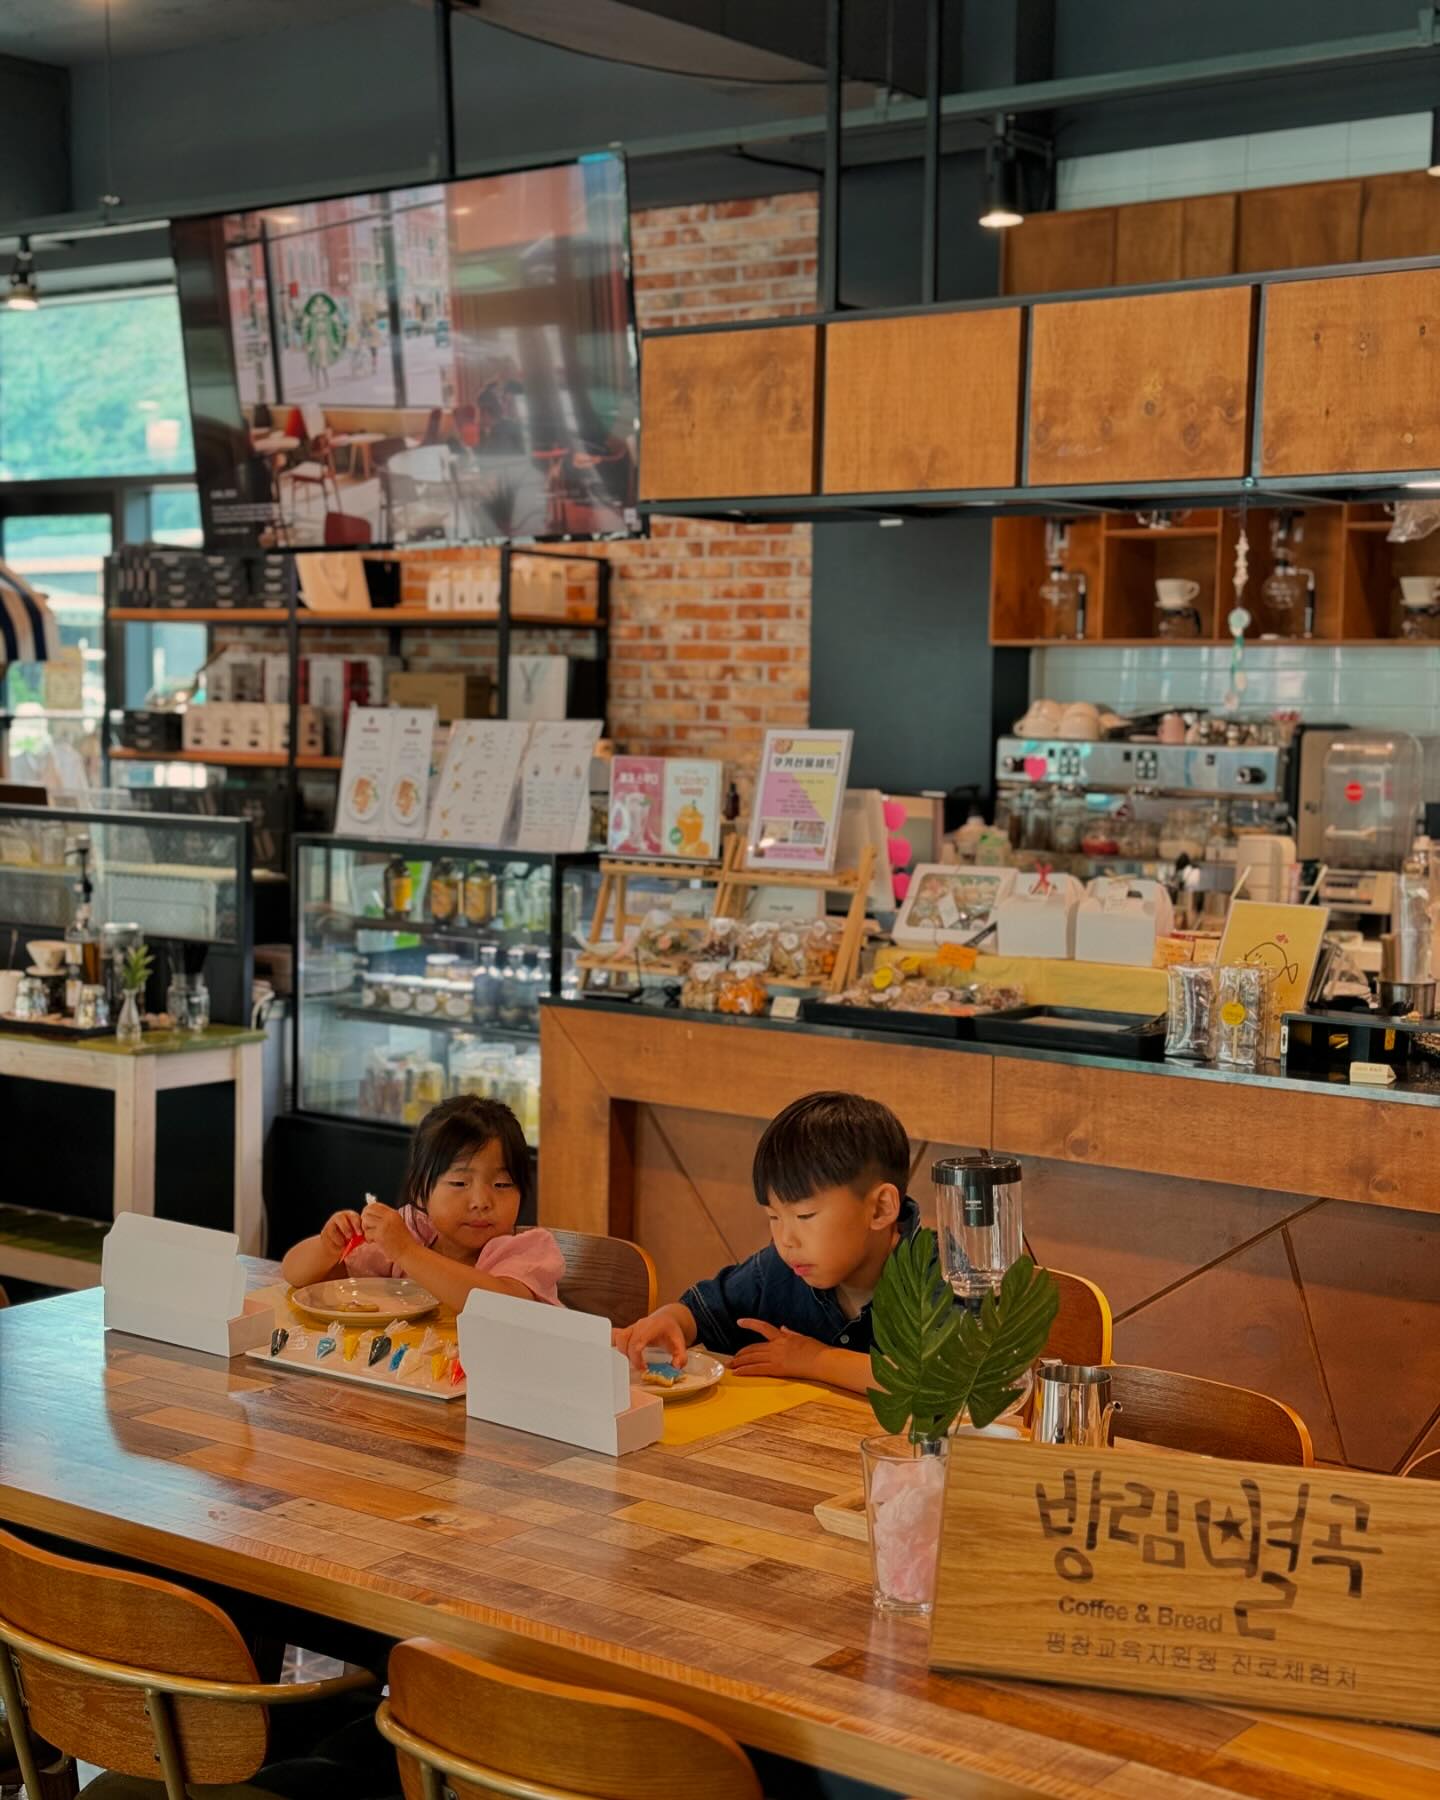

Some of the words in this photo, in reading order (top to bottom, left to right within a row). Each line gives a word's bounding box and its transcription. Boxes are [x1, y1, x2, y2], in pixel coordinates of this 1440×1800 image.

[1036, 1469, 1384, 1640] 방림별곡
[1058, 1595, 1129, 1622] Coffee
[1134, 1603, 1151, 1625] &
[1157, 1606, 1224, 1634] Bread
[1046, 1630, 1218, 1673] 평창교육지원청
